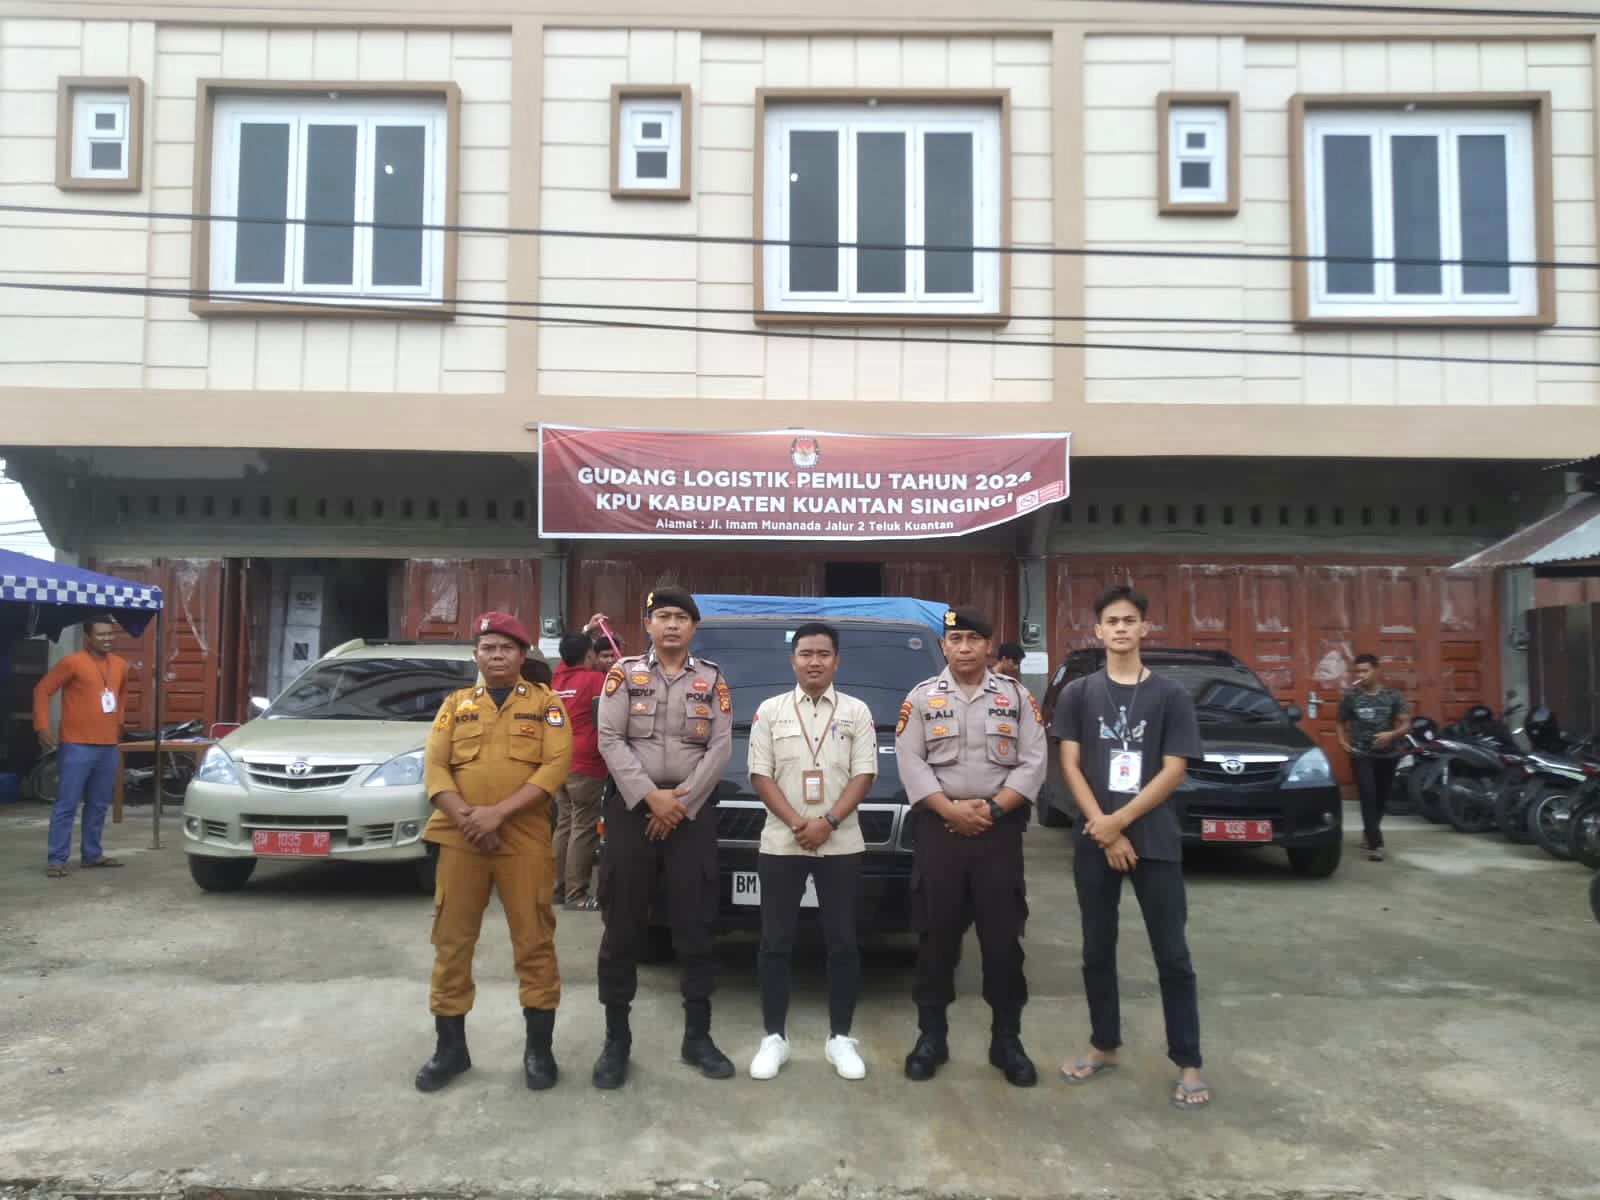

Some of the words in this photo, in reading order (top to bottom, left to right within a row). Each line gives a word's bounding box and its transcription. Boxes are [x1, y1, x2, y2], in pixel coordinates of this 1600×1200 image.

[577, 466, 677, 486] GUDANG
[683, 470, 790, 488] LOGISTIK
[796, 472, 881, 489] PEMILU
[888, 473, 968, 490] TAHUN
[975, 471, 1032, 490] 2024
[596, 493, 641, 510] KPU
[648, 494, 785, 513] KABUPATEN
[793, 496, 903, 514] KUANTAN
[910, 492, 1013, 514] SINGINGI
[655, 518, 698, 529] Alamat
[708, 519, 722, 529] Jl.
[725, 520, 758, 529] Imam
[761, 520, 821, 531] Munanada
[825, 521, 854, 531] Jalur
[857, 521, 865, 531] 2
[868, 521, 900, 531] Teluk
[904, 521, 954, 531] Kuantan
[736, 875, 757, 893] BM
